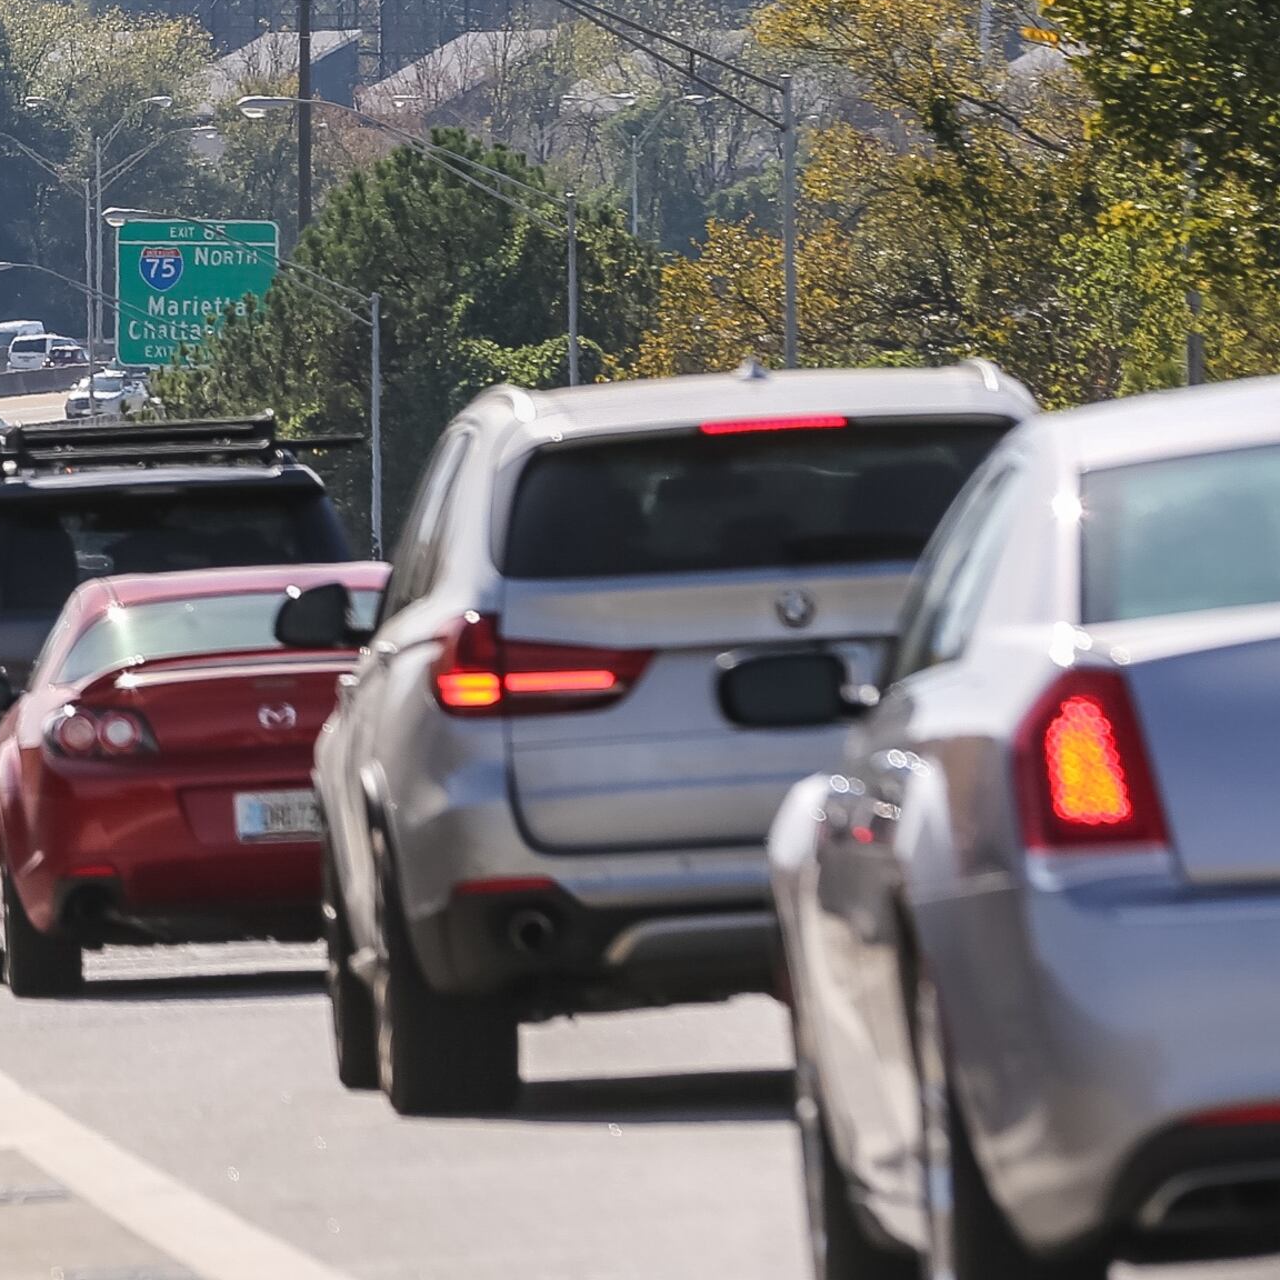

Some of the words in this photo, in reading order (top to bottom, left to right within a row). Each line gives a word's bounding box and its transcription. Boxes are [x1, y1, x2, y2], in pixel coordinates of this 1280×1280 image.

[170, 227, 195, 238] EXIT
[146, 258, 176, 278] 75
[194, 247, 258, 266] NORTH
[148, 296, 247, 316] Marieta
[144, 345, 176, 358] EXIT
